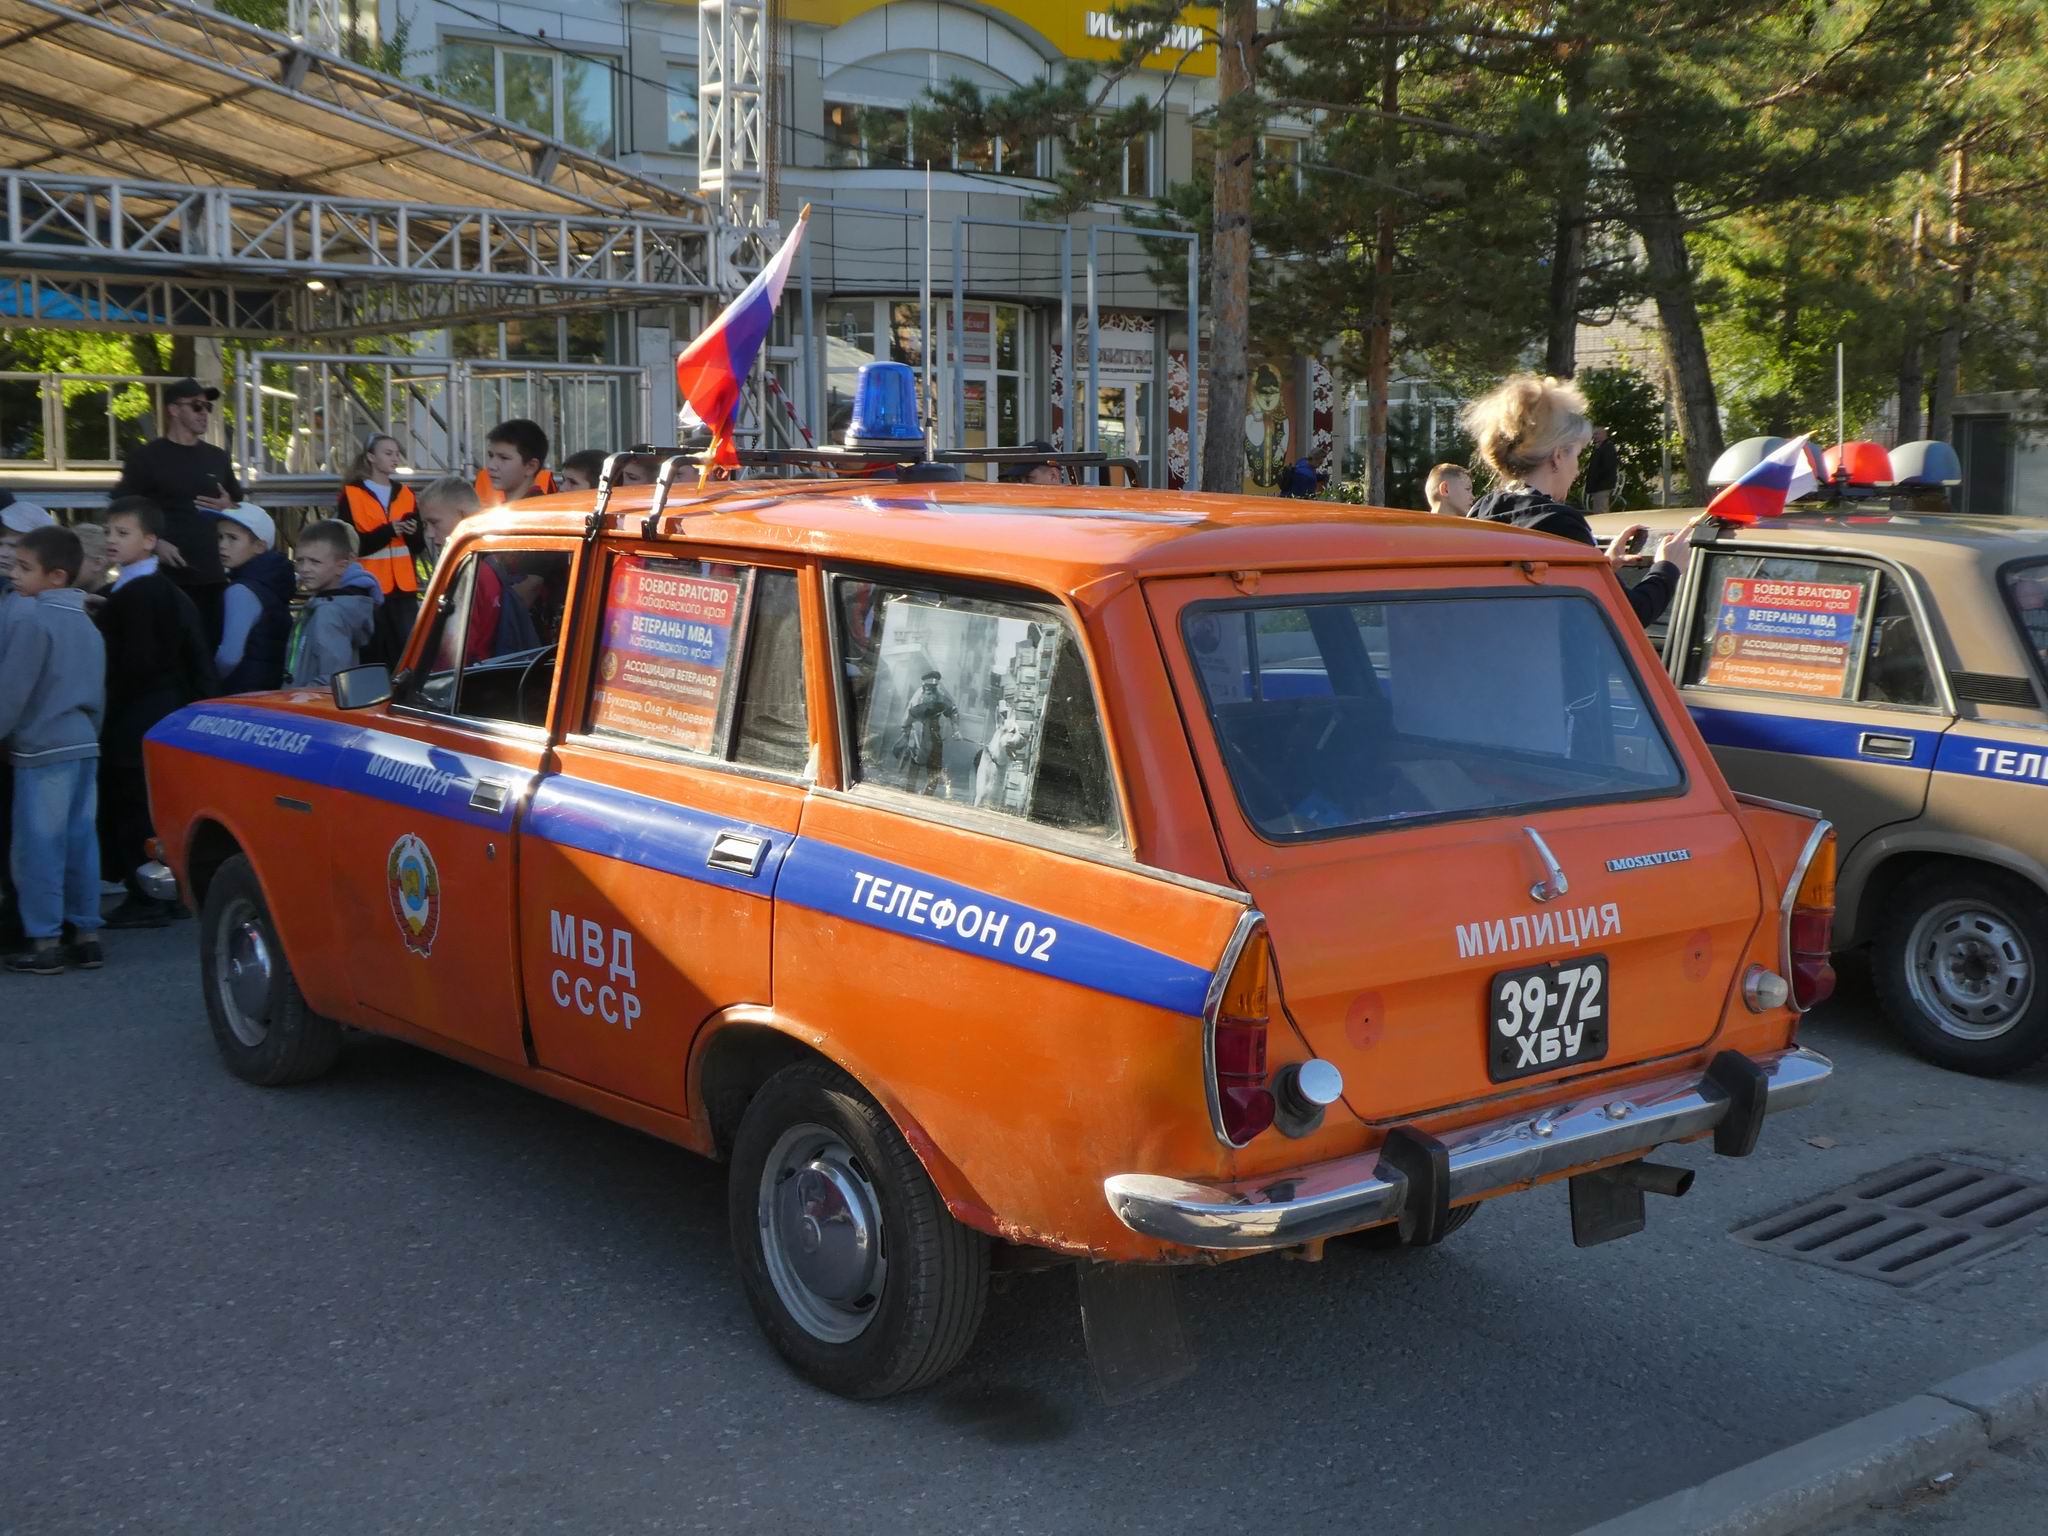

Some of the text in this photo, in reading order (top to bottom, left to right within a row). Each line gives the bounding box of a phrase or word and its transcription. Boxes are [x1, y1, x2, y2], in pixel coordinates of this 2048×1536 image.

[639, 577, 729, 604] БОЕВОЕ БРАТСТВО
[1752, 594, 1850, 611] Хабаровского края
[1753, 583, 1852, 600] БОЕВОЕ БРАТСТВО
[636, 593, 727, 620] Хабаровского края
[1748, 609, 1837, 629] ВЕТЕРАНЫ МВД
[632, 615, 714, 648] ВЕТЕРАНЫ МВД
[1745, 622, 1812, 636] Хабаровского
[628, 633, 689, 656] Хабаровского
[1742, 639, 1844, 655] АССОЦИАЦИЯ ВЕТЕРАНОВ
[624, 659, 718, 688] АССОЦИАЦИЯ ВЕТЕРАНОВ
[1767, 666, 1790, 677] Олег
[644, 700, 665, 717] Олег
[665, 705, 714, 727] Андреевич
[187, 714, 312, 755] КИНОЛОГИЧЕСКАЯ
[365, 753, 456, 796] МИЛИЦИЯ
[1612, 849, 1690, 871] MOSKVICH
[852, 871, 1057, 962] ТЕЛЕФОН 02
[1455, 902, 1622, 958] МИЛИЦИЯ
[550, 909, 636, 989] МВД
[551, 969, 641, 1030] СССР
[1497, 964, 1602, 1037] 39-72
[1516, 1021, 1584, 1069] ХБУ
